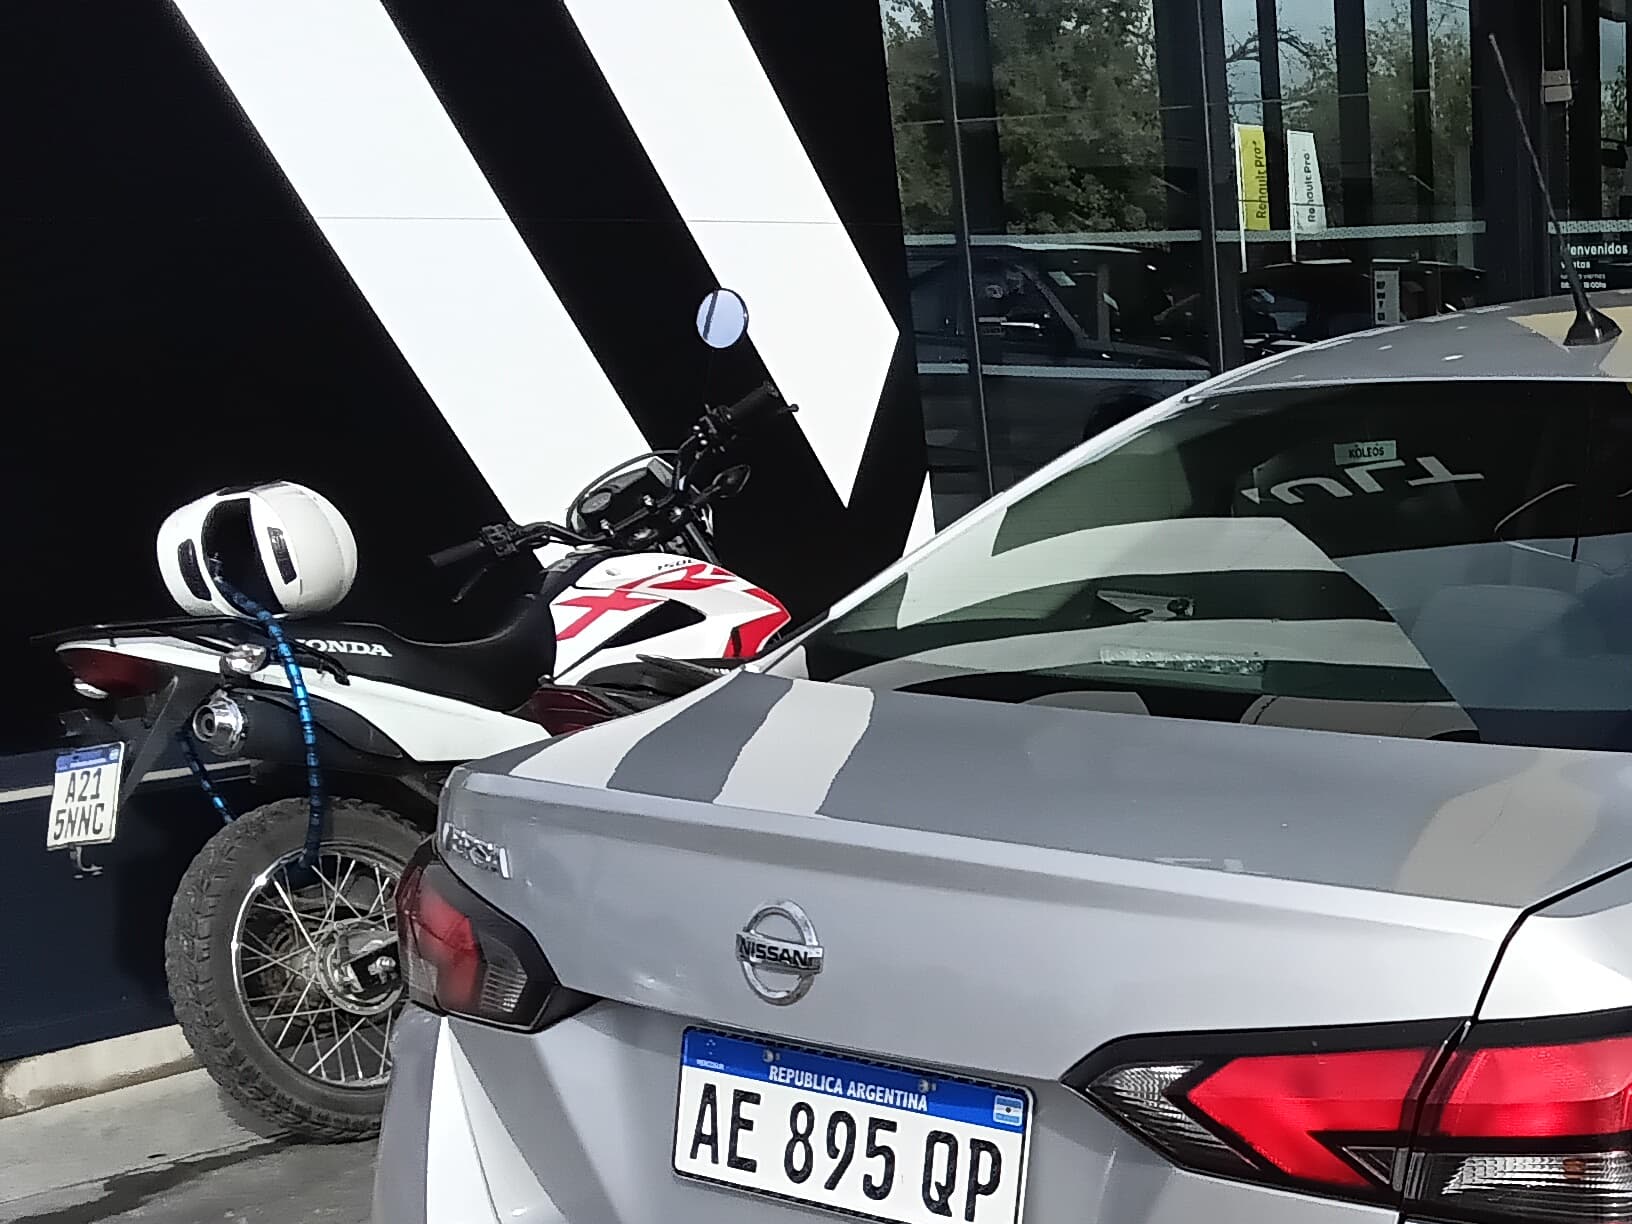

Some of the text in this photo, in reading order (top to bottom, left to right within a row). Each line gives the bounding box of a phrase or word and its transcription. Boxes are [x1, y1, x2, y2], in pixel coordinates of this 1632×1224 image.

[1561, 243, 1628, 256] ienvenidos
[295, 638, 393, 658] ONDA
[65, 768, 102, 804] A21
[53, 803, 105, 841] 5NNC
[738, 936, 809, 968] NISSAN
[769, 1065, 929, 1113] REPUBLICA ARGENTINA
[689, 1083, 1003, 1223] AE 895 QP
